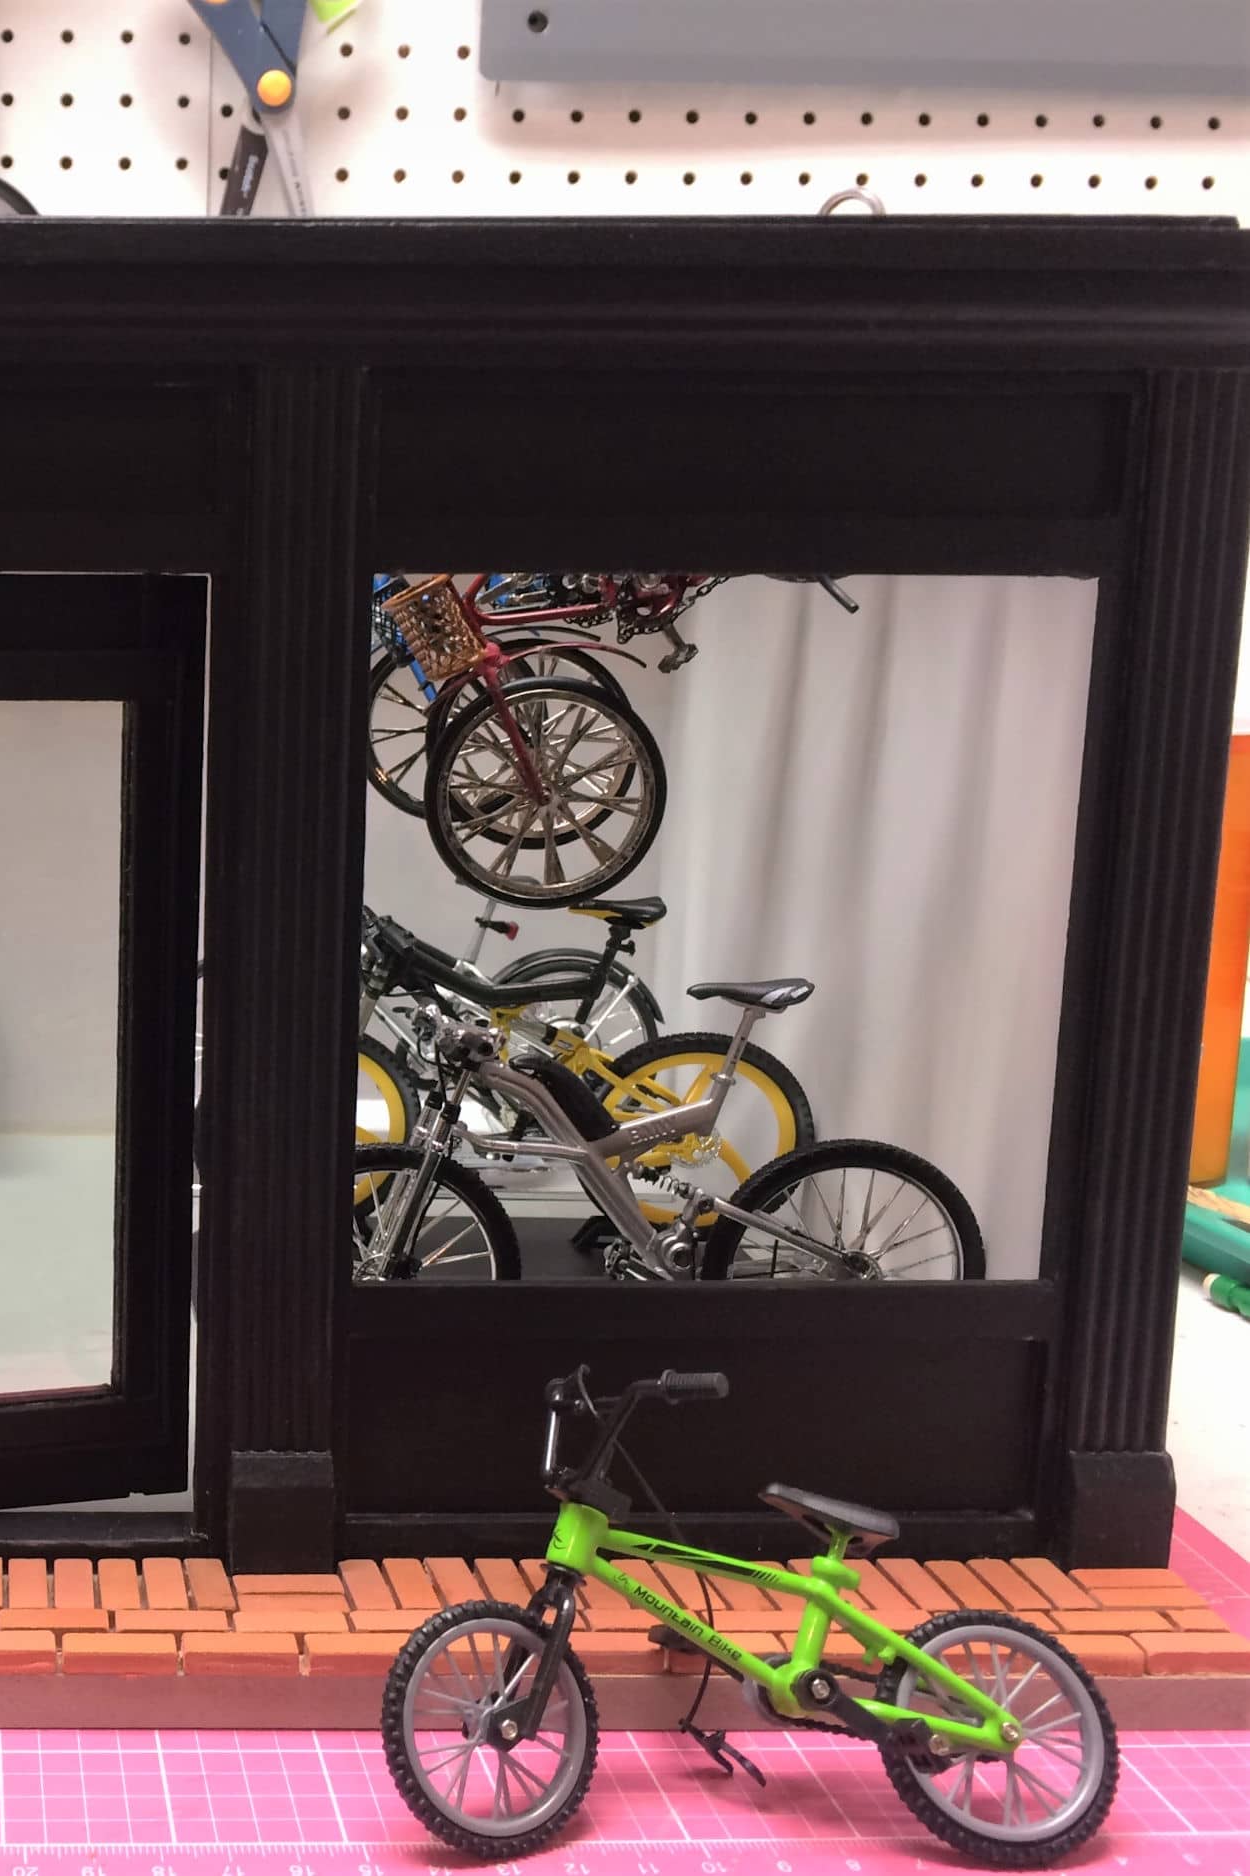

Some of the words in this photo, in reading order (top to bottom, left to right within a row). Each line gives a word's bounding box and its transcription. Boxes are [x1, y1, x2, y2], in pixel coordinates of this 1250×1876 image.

[633, 1585, 704, 1638] Mountain
[707, 1633, 743, 1661] Bike
[12, 1866, 39, 1876] 20
[151, 1866, 177, 1876] 18
[289, 1865, 317, 1876] 16
[358, 1864, 385, 1876] 15
[564, 1863, 591, 1876] 12
[638, 1863, 660, 1875] 11
[701, 1861, 727, 1874] 10
